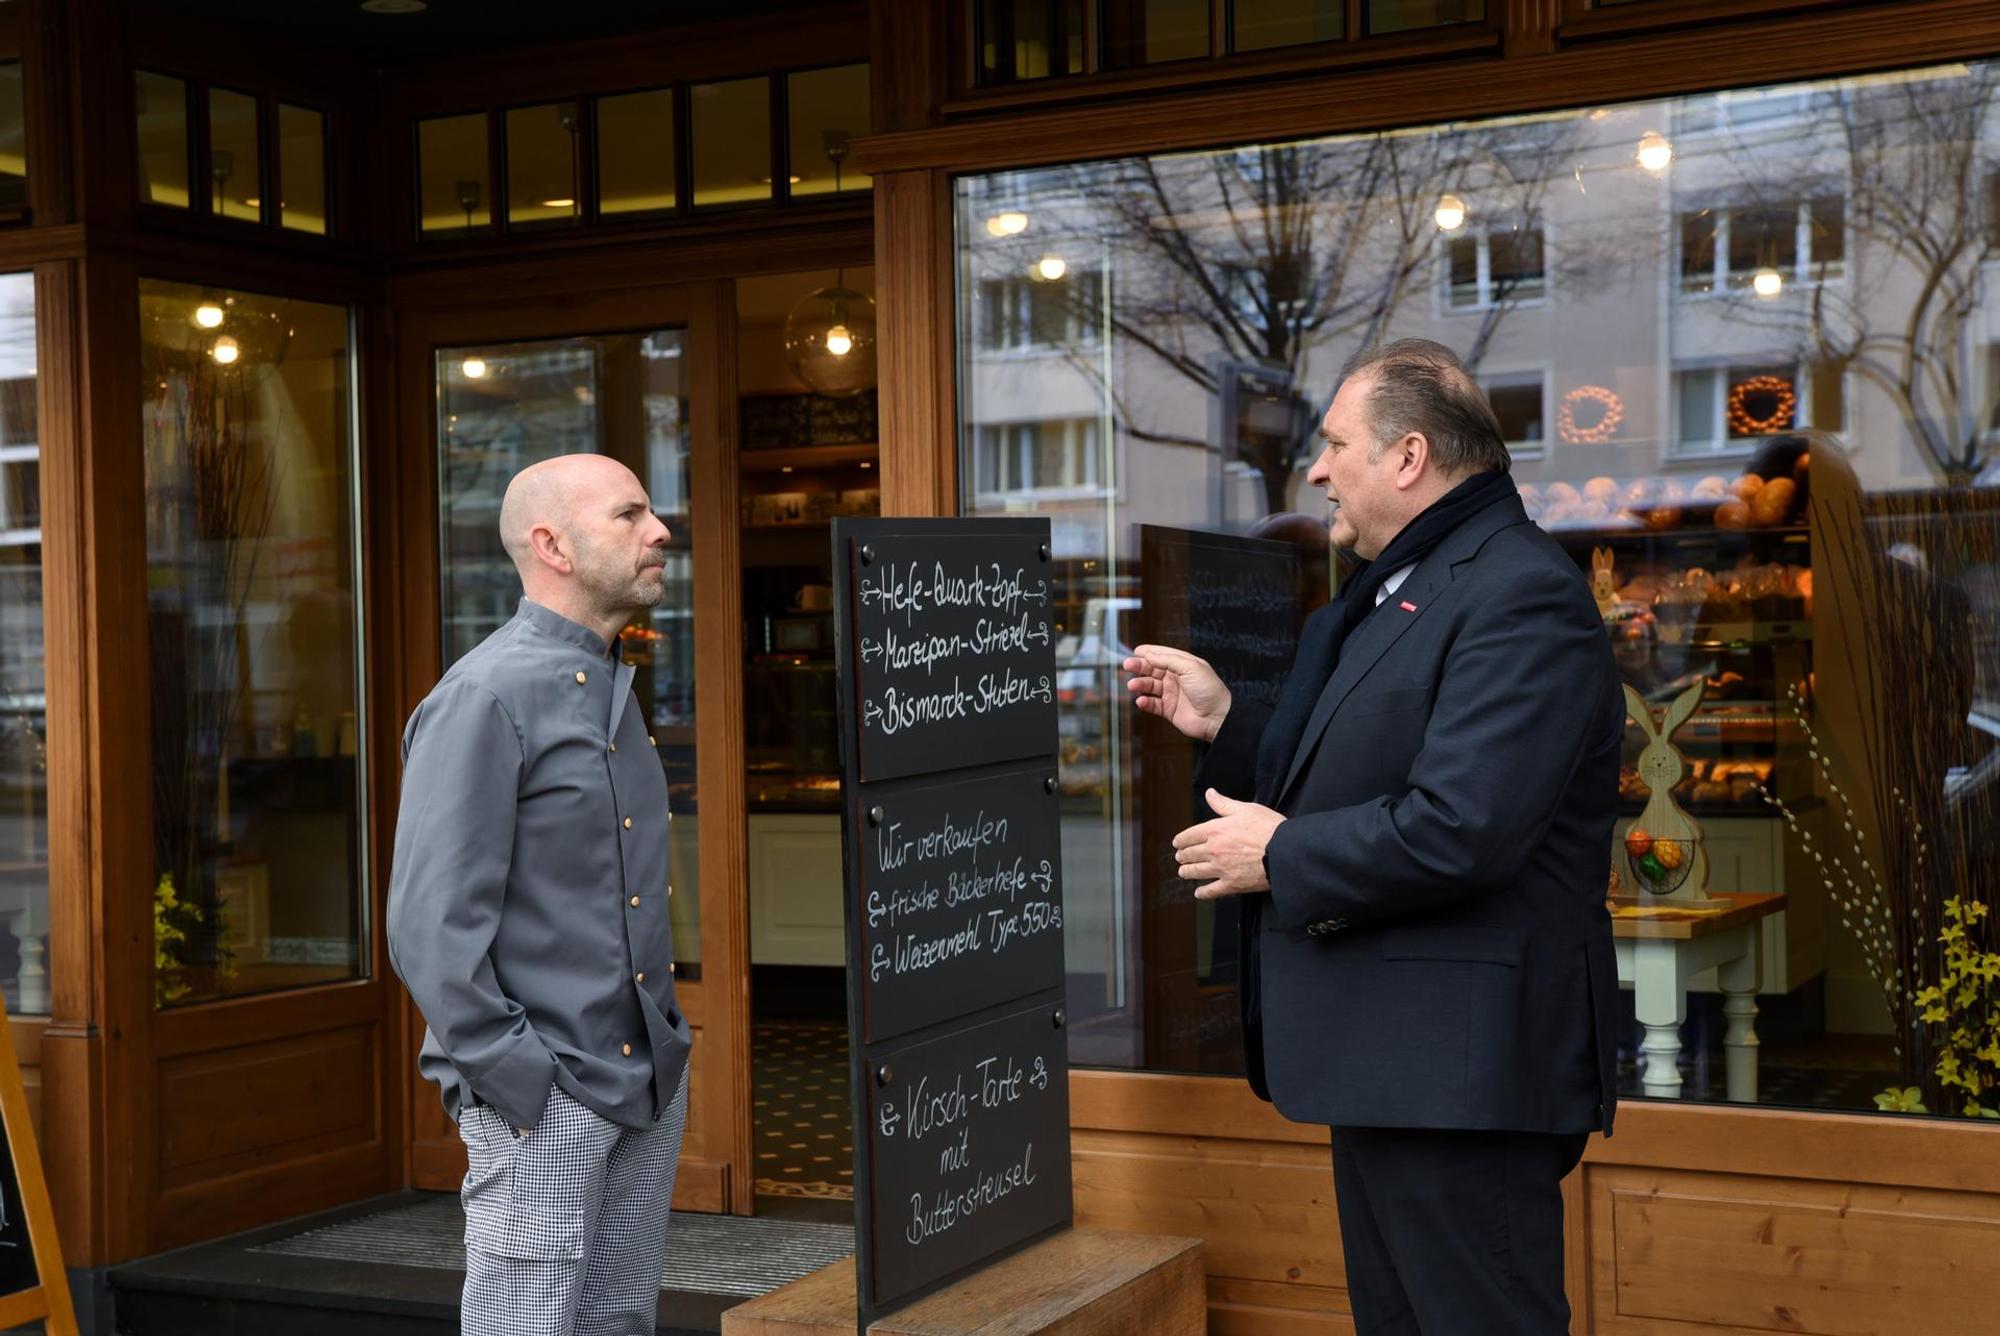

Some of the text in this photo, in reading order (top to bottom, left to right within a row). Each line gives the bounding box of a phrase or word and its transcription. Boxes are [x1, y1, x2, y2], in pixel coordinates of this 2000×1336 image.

[884, 611, 1029, 676] Marzipan-Striezel
[881, 667, 1030, 735] Bismarck-Stuten
[878, 810, 1008, 872] Wir verkaufen
[888, 856, 1027, 928] frische Bäckerhefe
[895, 902, 1050, 974] Weizenmehl Type 550
[940, 1126, 970, 1175] mit
[906, 1143, 1037, 1245] Butterstreusel
